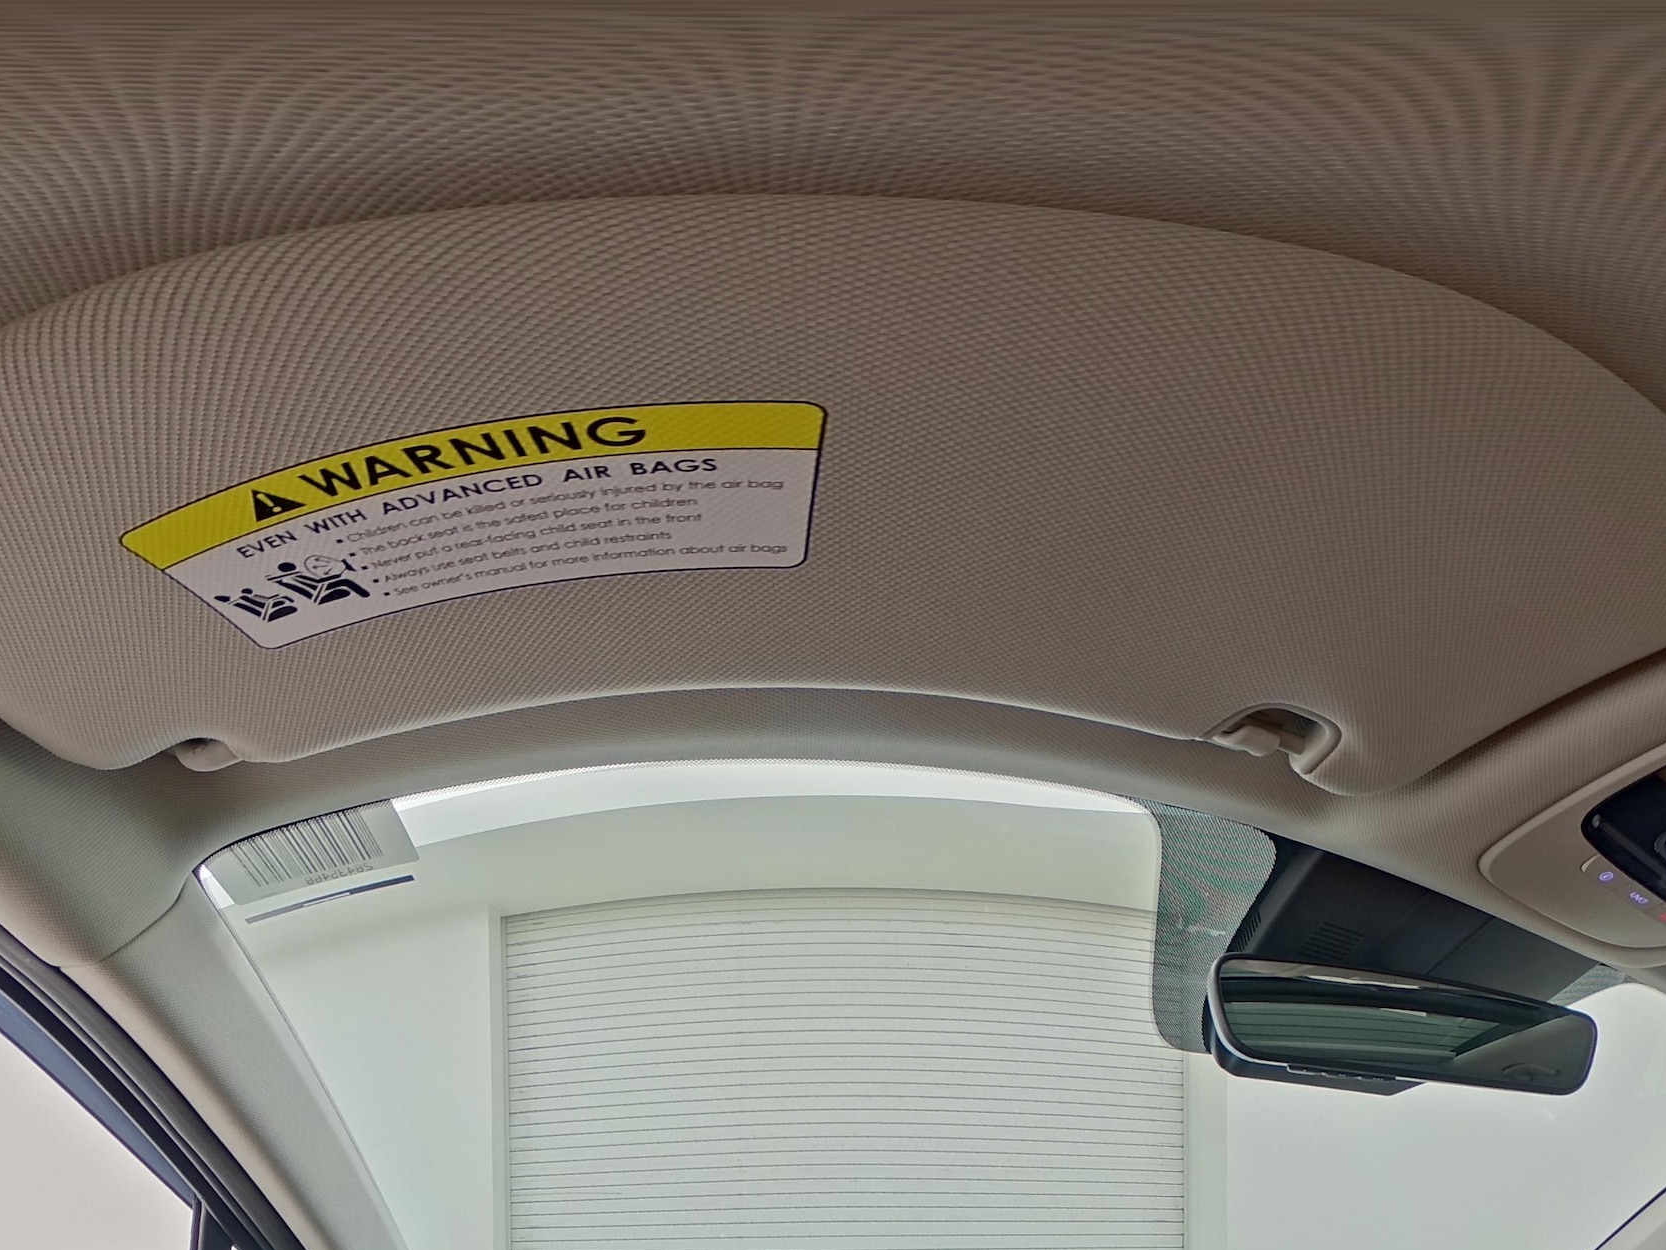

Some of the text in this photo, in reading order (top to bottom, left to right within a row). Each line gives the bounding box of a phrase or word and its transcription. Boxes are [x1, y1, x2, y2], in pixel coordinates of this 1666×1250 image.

[298, 417, 646, 497] WARNING
[237, 458, 718, 559] EVEN WITH ADVANCED AIR BAGS
[347, 478, 785, 543] Children can be killed or seriously injured by the air bag
[360, 497, 699, 557] The back seat is the safest place for children
[371, 512, 703, 571] Never put a rear-facing child seat in the front
[383, 530, 674, 584] Always use seat belts and child restraints
[393, 542, 789, 598] See owner's manual for more information about air bags
